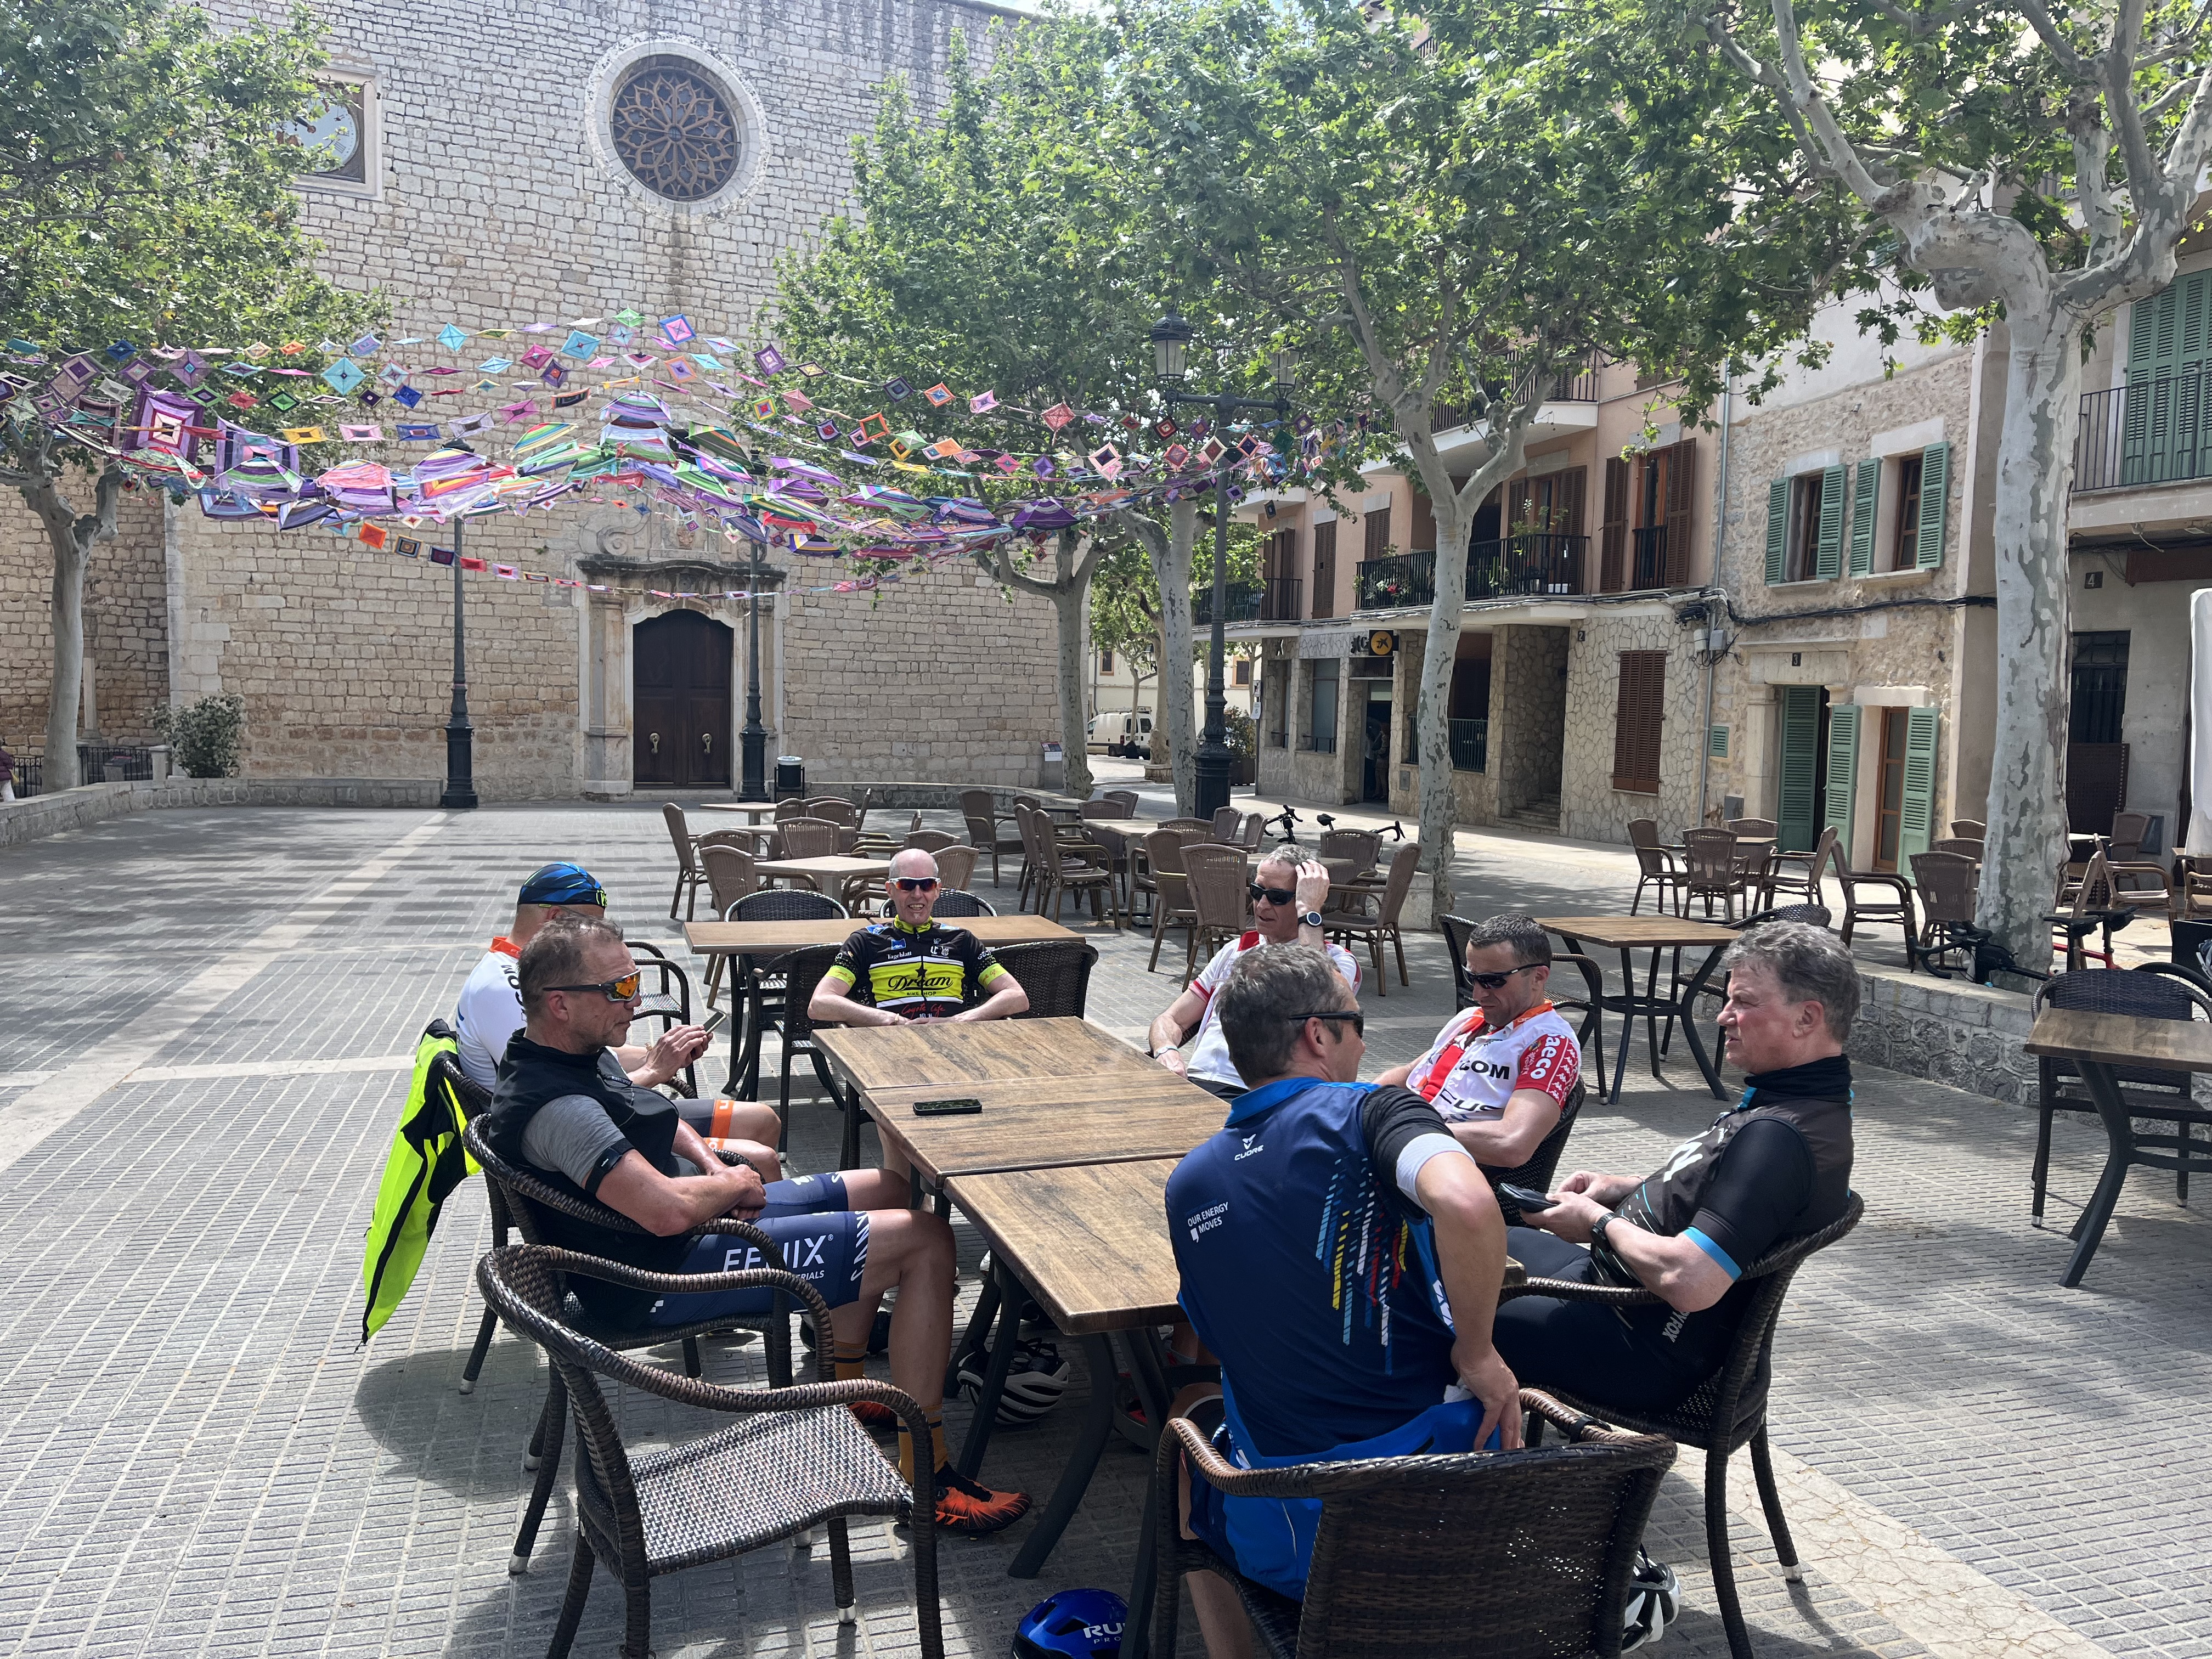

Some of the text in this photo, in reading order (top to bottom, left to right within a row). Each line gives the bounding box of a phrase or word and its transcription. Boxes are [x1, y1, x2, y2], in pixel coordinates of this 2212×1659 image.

[2088, 573, 2095, 587] 4
[1579, 631, 1583, 641] 2
[1793, 654, 1798, 665] 3
[887, 951, 912, 960] Tageblatt
[887, 975, 953, 991] Dream
[1234, 1145, 1264, 1161] CUORE
[1187, 1201, 1229, 1227] OUR ENERGY
[1198, 1216, 1222, 1234] MOVES
